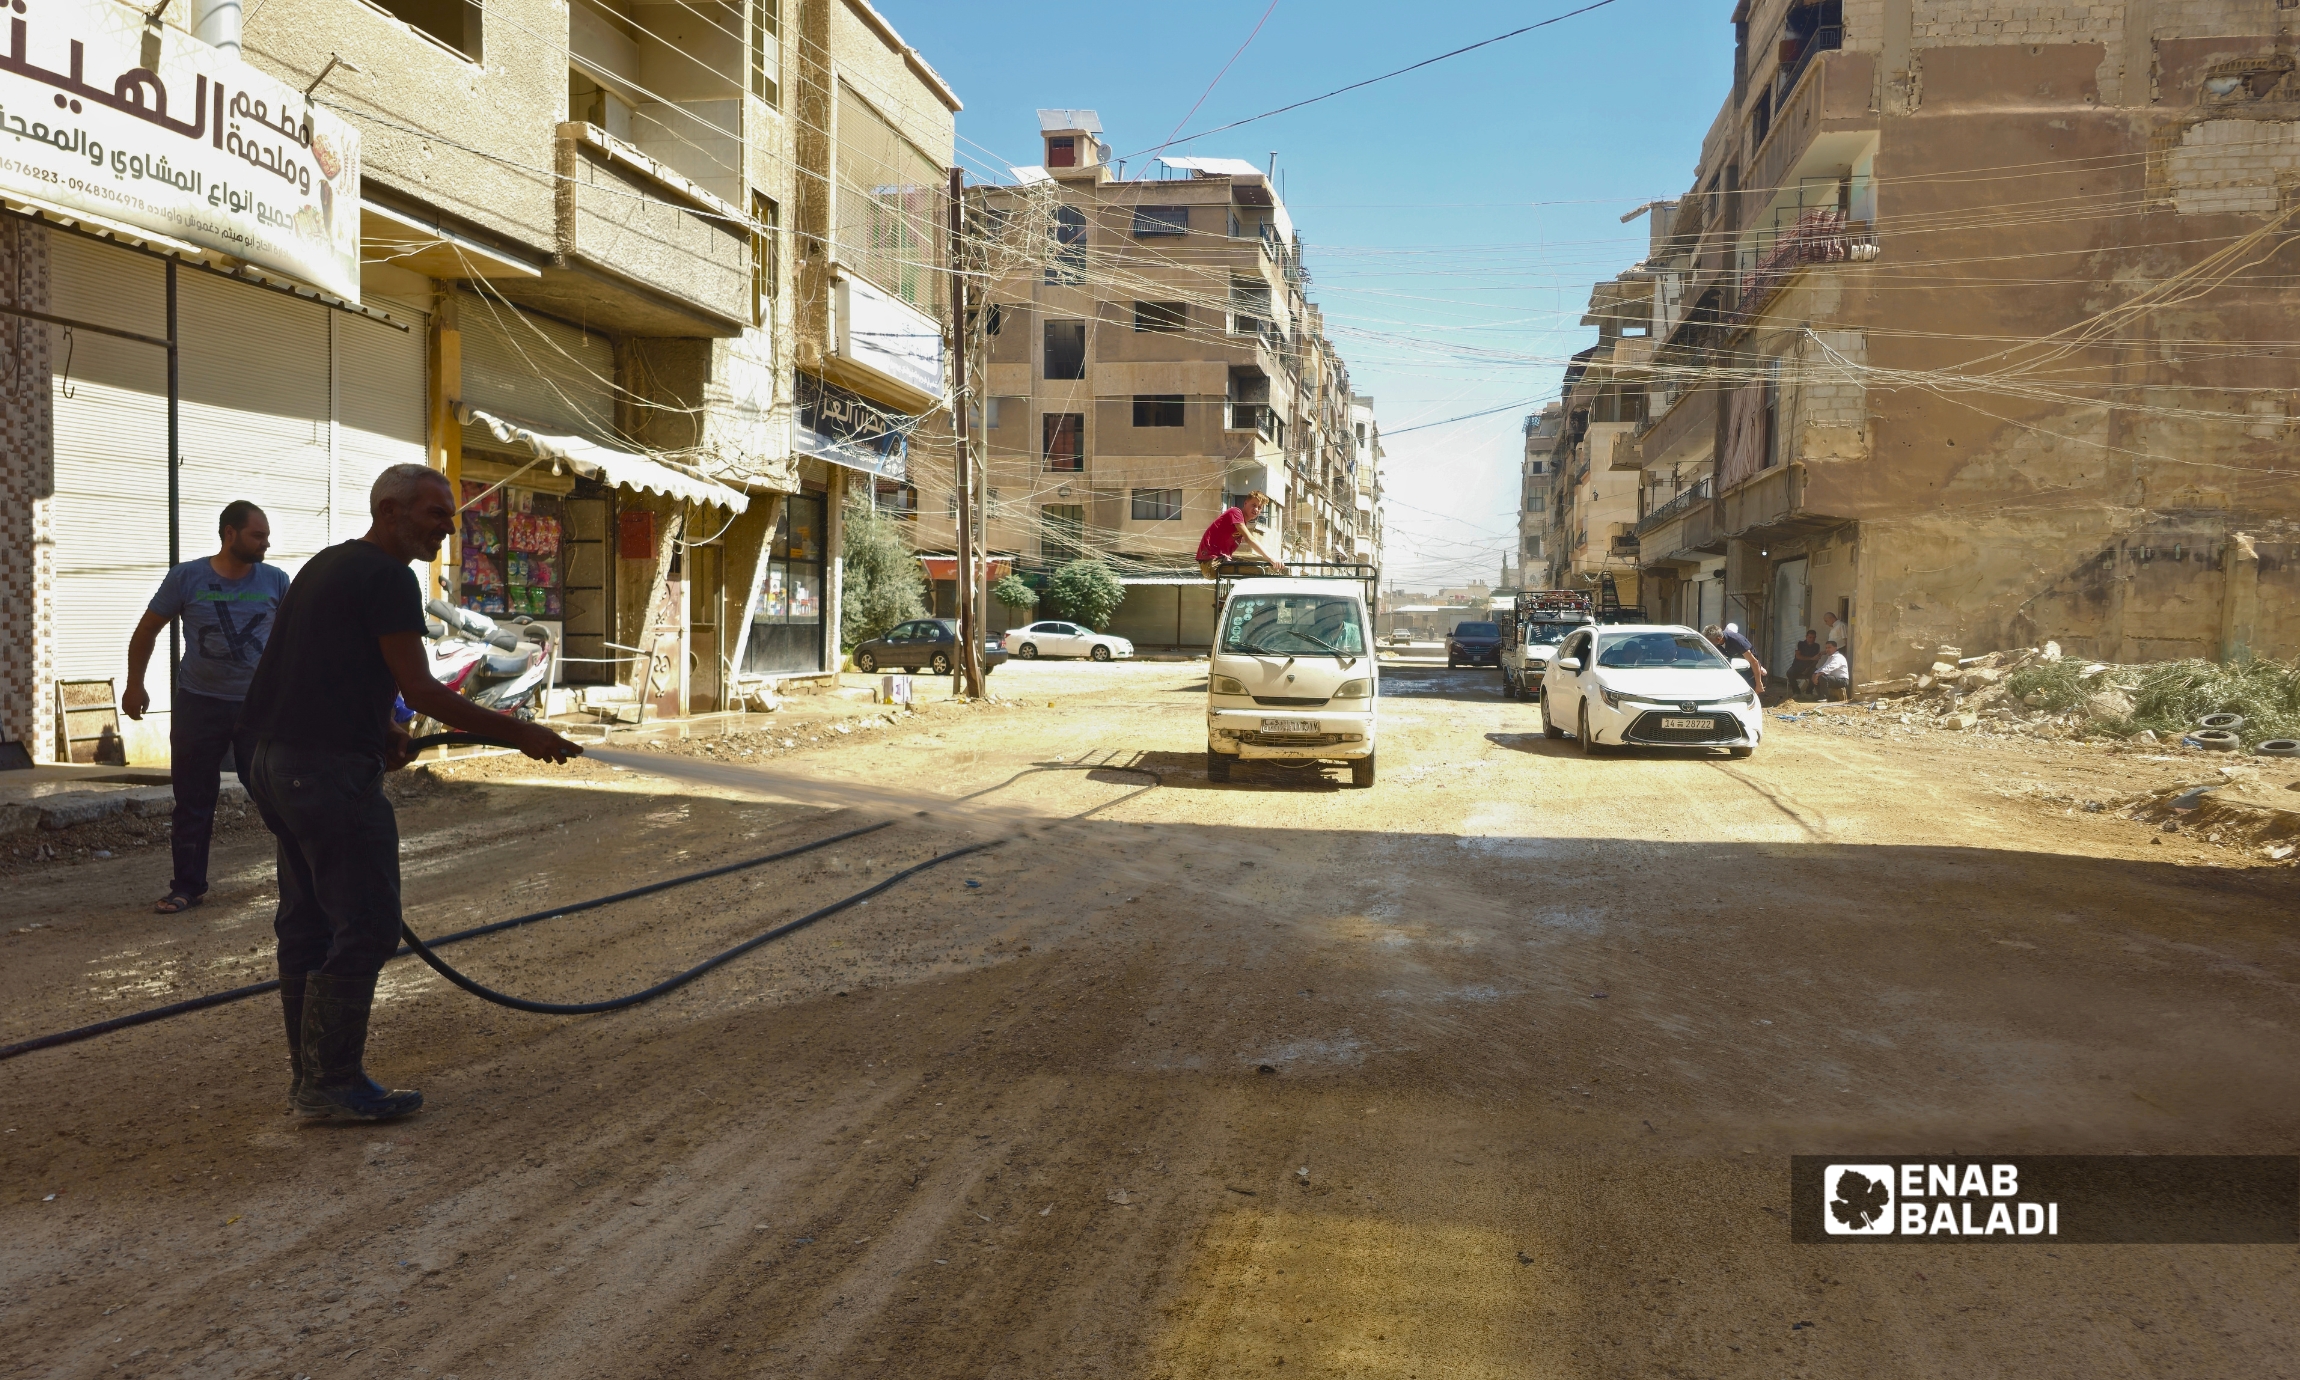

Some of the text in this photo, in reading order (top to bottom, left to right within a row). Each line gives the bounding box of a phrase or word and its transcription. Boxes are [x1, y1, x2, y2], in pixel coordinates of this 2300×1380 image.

[230, 90, 313, 149] مطعم
[110, 149, 202, 196] المشاوي
[226, 122, 311, 196] وملحمة
[68, 177, 145, 210] 0948304978
[221, 227, 243, 243] هيثم
[257, 201, 294, 235] جميع
